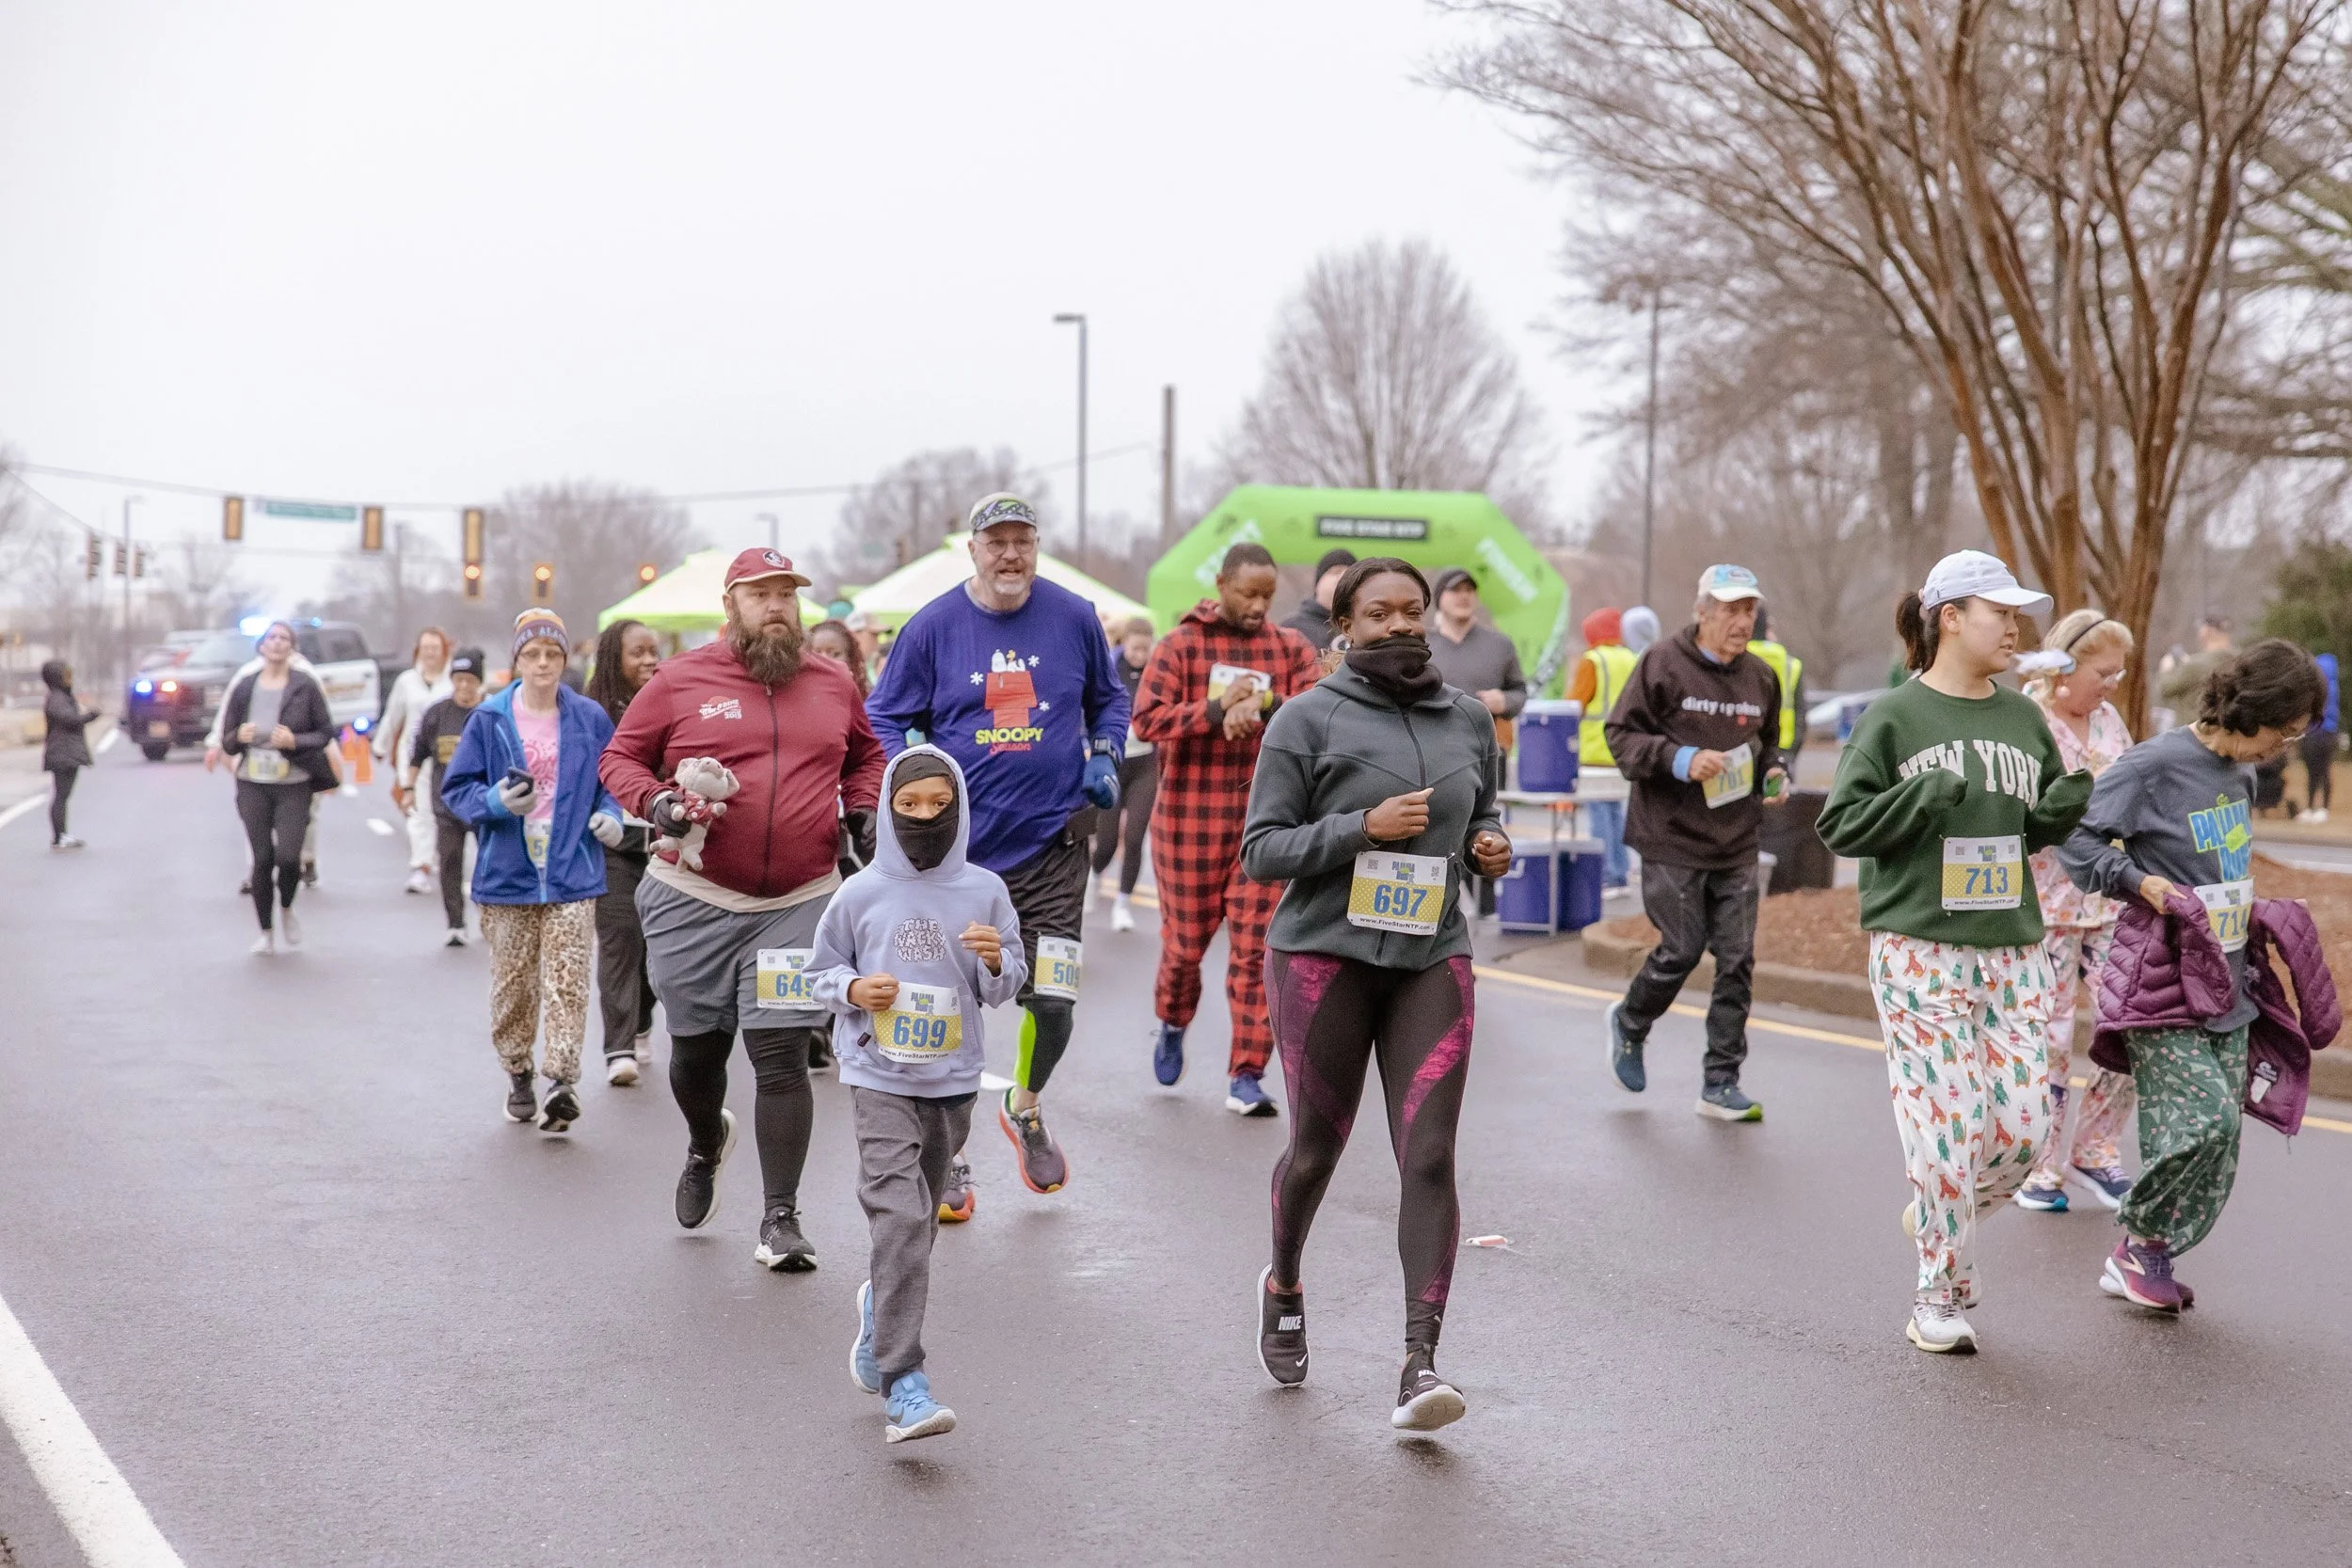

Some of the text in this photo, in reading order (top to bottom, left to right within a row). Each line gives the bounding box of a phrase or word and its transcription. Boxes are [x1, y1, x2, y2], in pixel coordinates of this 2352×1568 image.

[1681, 696, 1718, 716] dirty
[976, 727, 1043, 745] SNOOPY
[1899, 739, 2042, 813] NEW YORK
[1965, 866, 2009, 895] 713
[1374, 884, 1427, 917] 697
[902, 918, 940, 932] THE
[1359, 917, 1431, 930] www.FiveStarNTP.com
[894, 1016, 947, 1048] 699
[1278, 1315, 1302, 1331] NIKE
